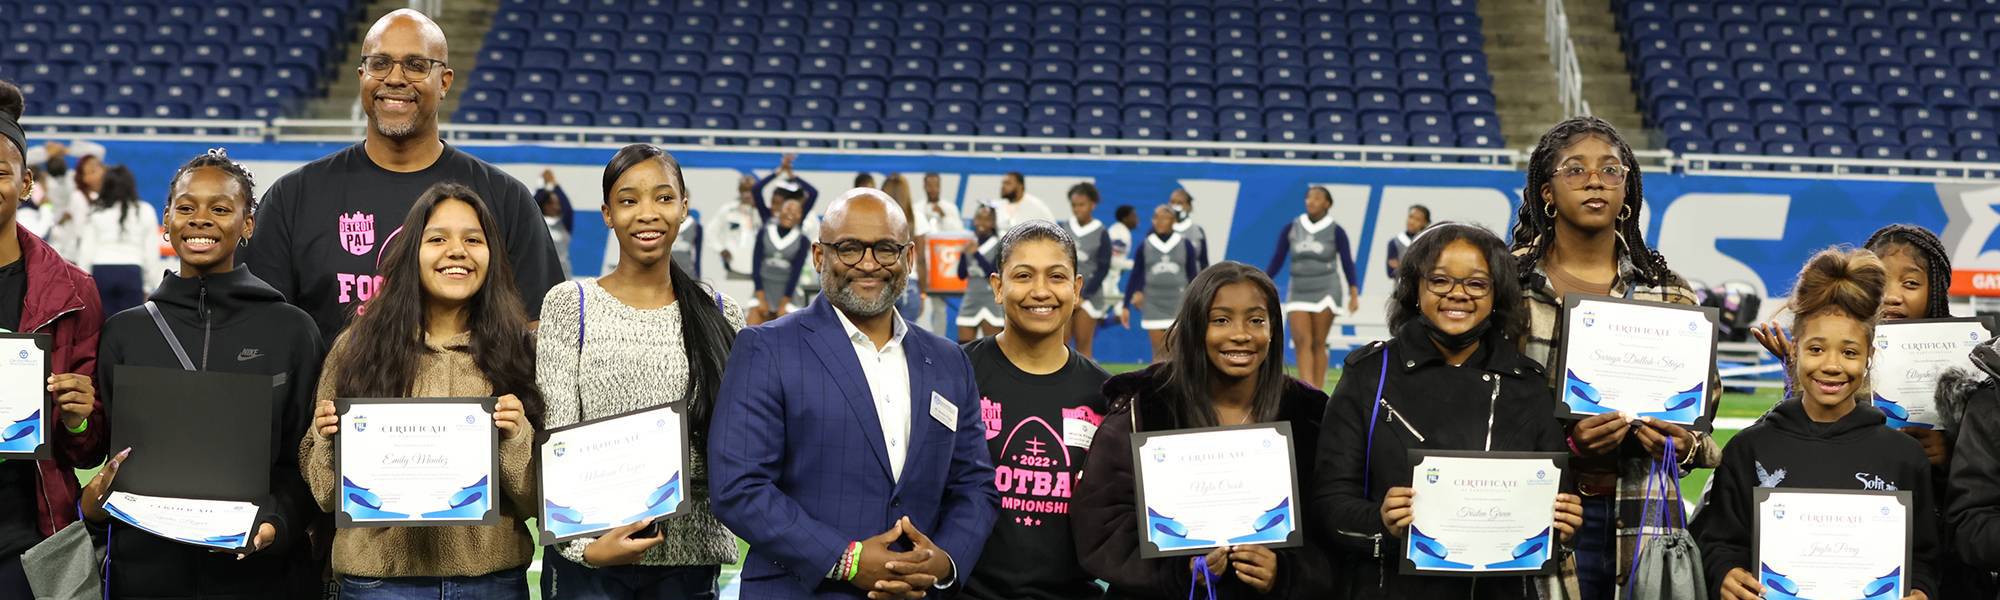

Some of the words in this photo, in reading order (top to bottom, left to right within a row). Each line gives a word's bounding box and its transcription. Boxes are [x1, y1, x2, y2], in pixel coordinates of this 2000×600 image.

[340, 221, 375, 232] DETROIT
[346, 233, 375, 252] PAL
[1608, 323, 1670, 336] CERTIFICATE
[1901, 341, 1956, 351] CERTIFICATE
[381, 424, 447, 434] CERTIFICATE
[1020, 455, 1051, 467] 2022
[994, 465, 1071, 498] OTBA
[1453, 479, 1518, 489] CERTIFICATE
[1002, 497, 1068, 514] MPIONSHI
[1800, 512, 1863, 524] CERTIFICATE
